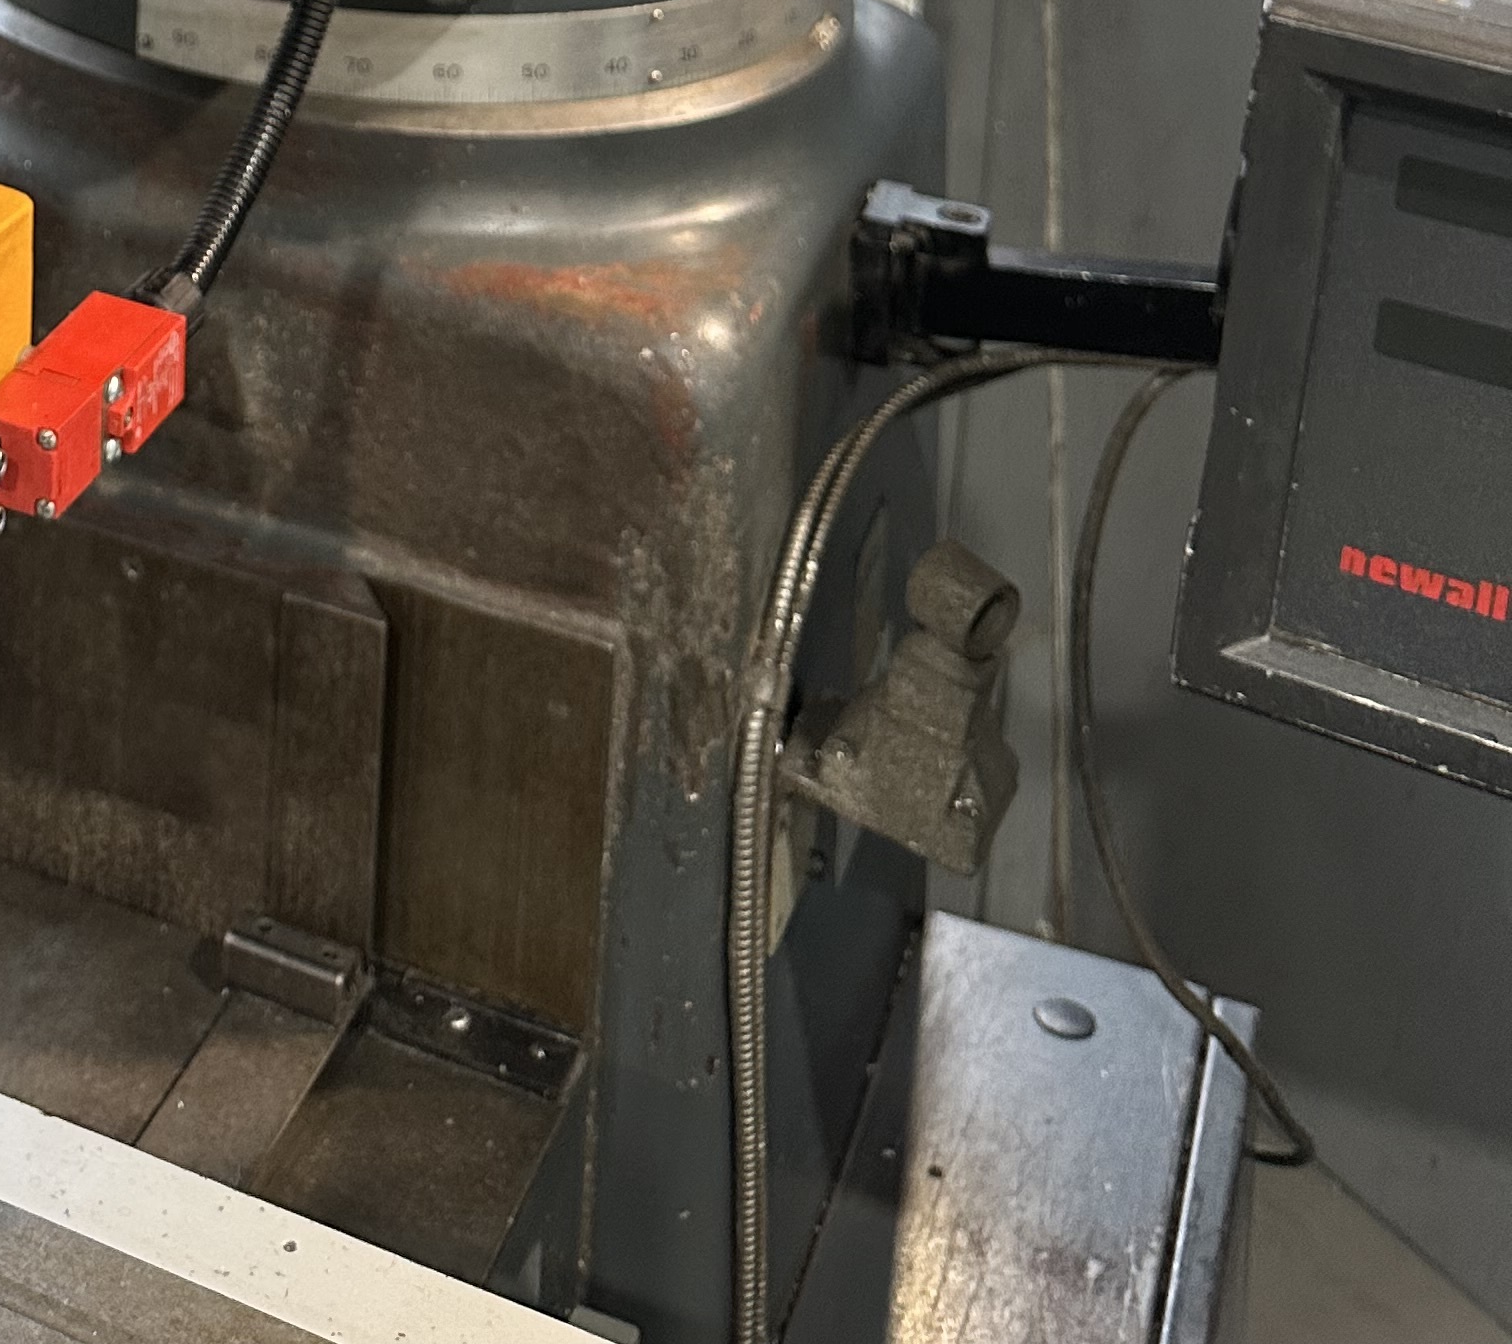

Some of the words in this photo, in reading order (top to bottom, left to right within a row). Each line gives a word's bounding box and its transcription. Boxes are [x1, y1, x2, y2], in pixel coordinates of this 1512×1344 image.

[344, 56, 373, 75] 70
[605, 56, 631, 74] 40
[1340, 545, 1509, 621] newall
